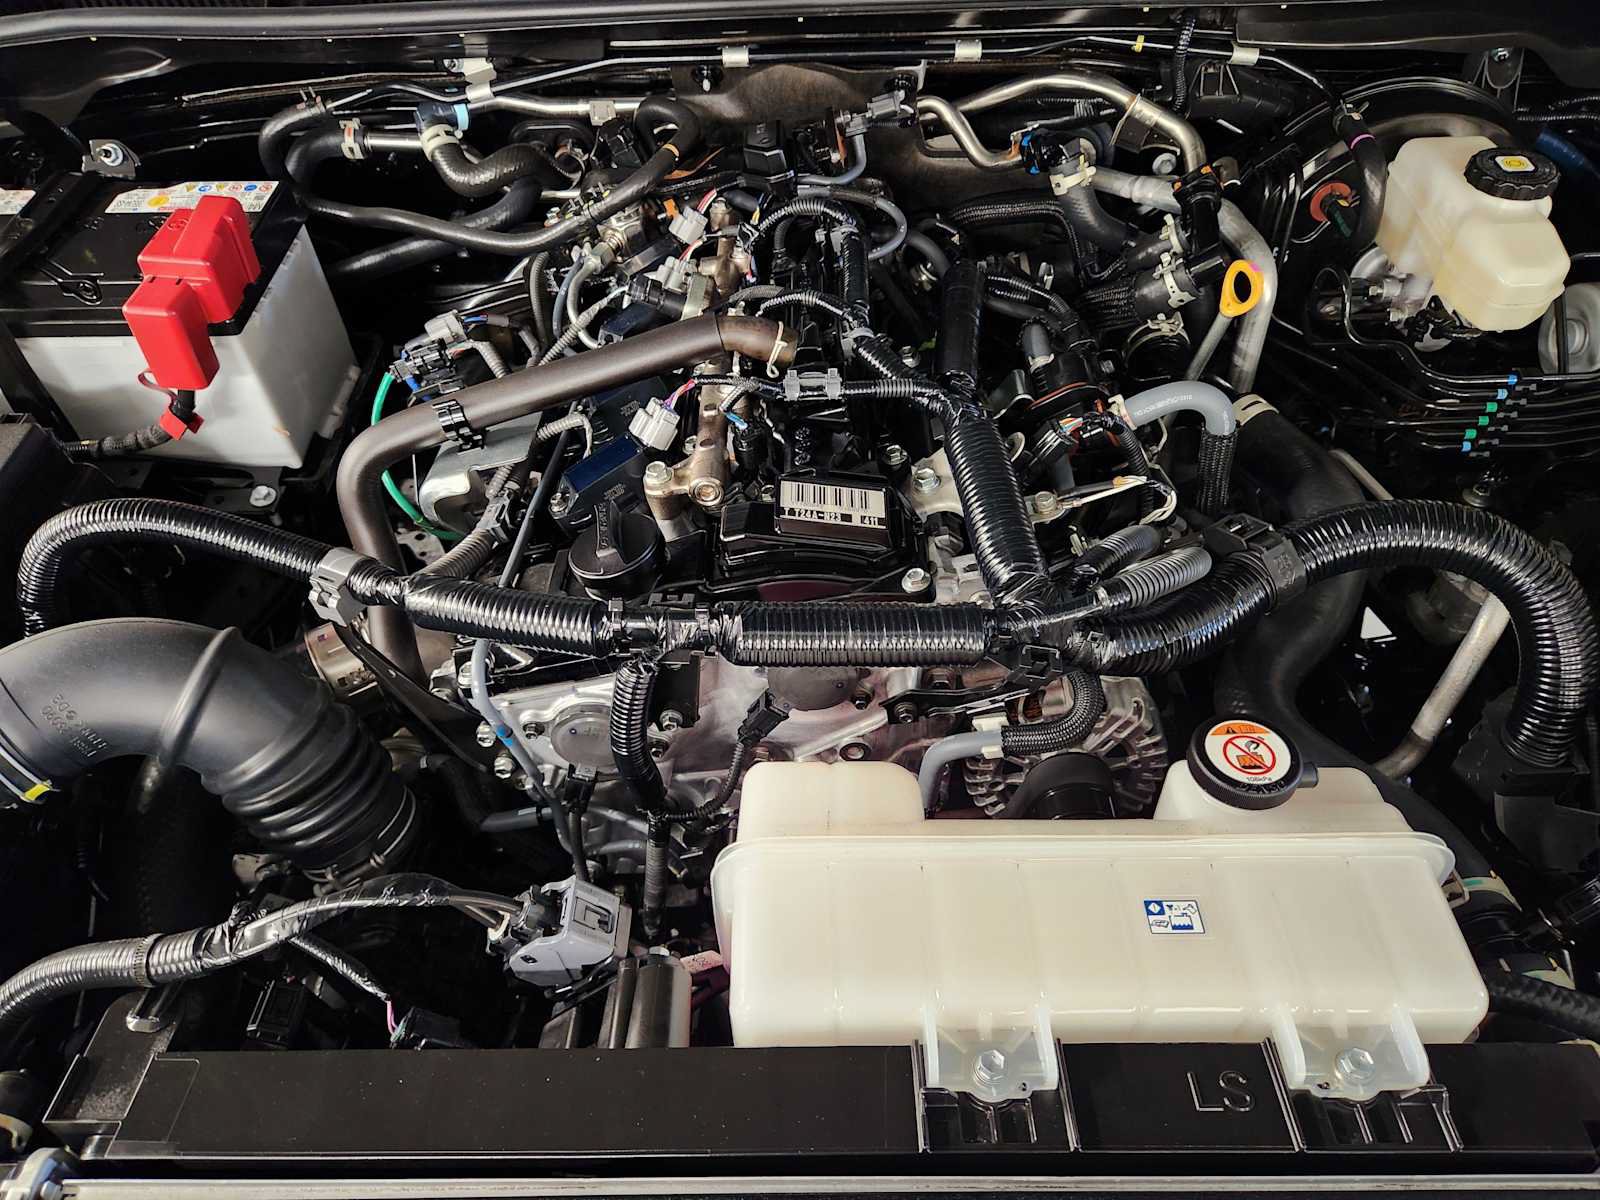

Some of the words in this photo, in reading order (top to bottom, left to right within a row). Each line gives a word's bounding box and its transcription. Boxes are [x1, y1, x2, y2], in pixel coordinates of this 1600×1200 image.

[794, 508, 842, 521] T24A-N23
[863, 515, 879, 526] 411
[1186, 1070, 1256, 1112] LS
